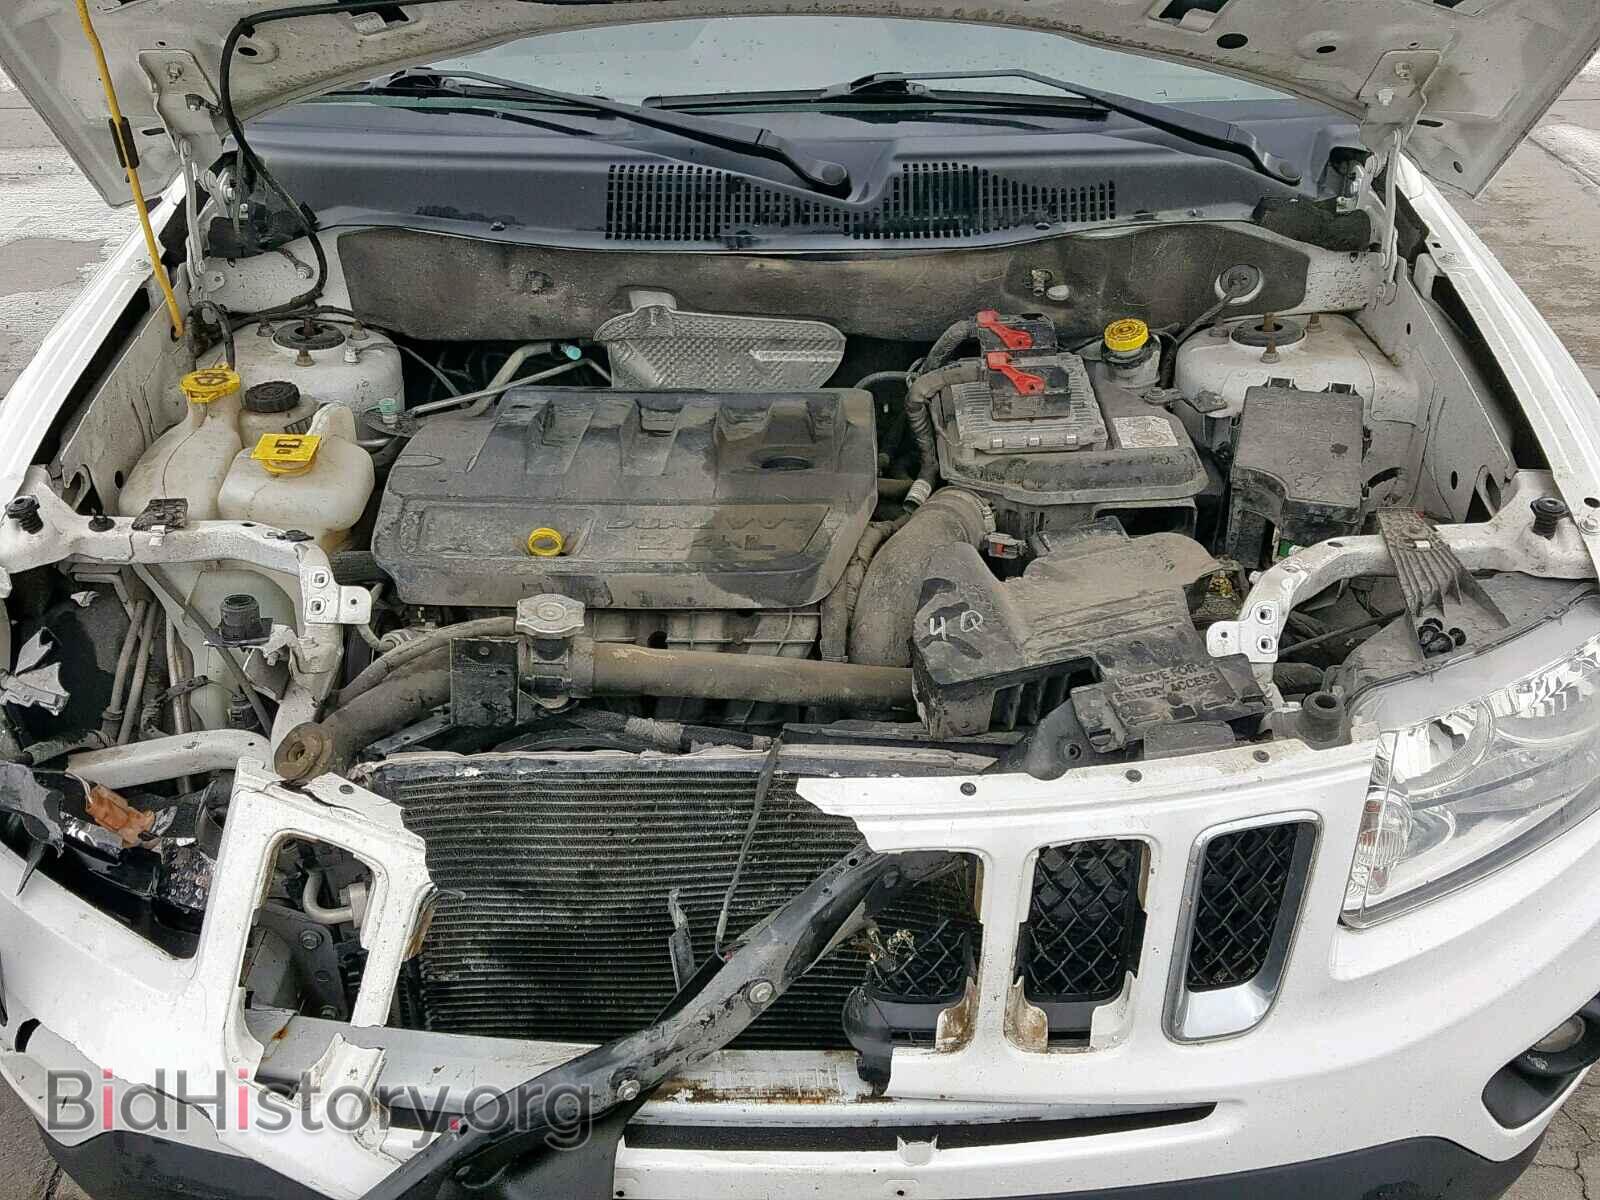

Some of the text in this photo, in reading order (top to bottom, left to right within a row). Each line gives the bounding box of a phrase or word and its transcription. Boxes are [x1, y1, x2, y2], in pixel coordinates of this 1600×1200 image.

[1113, 672, 1218, 701] BATTERY ACCESS
[1117, 663, 1198, 688] REMOVE FOR
